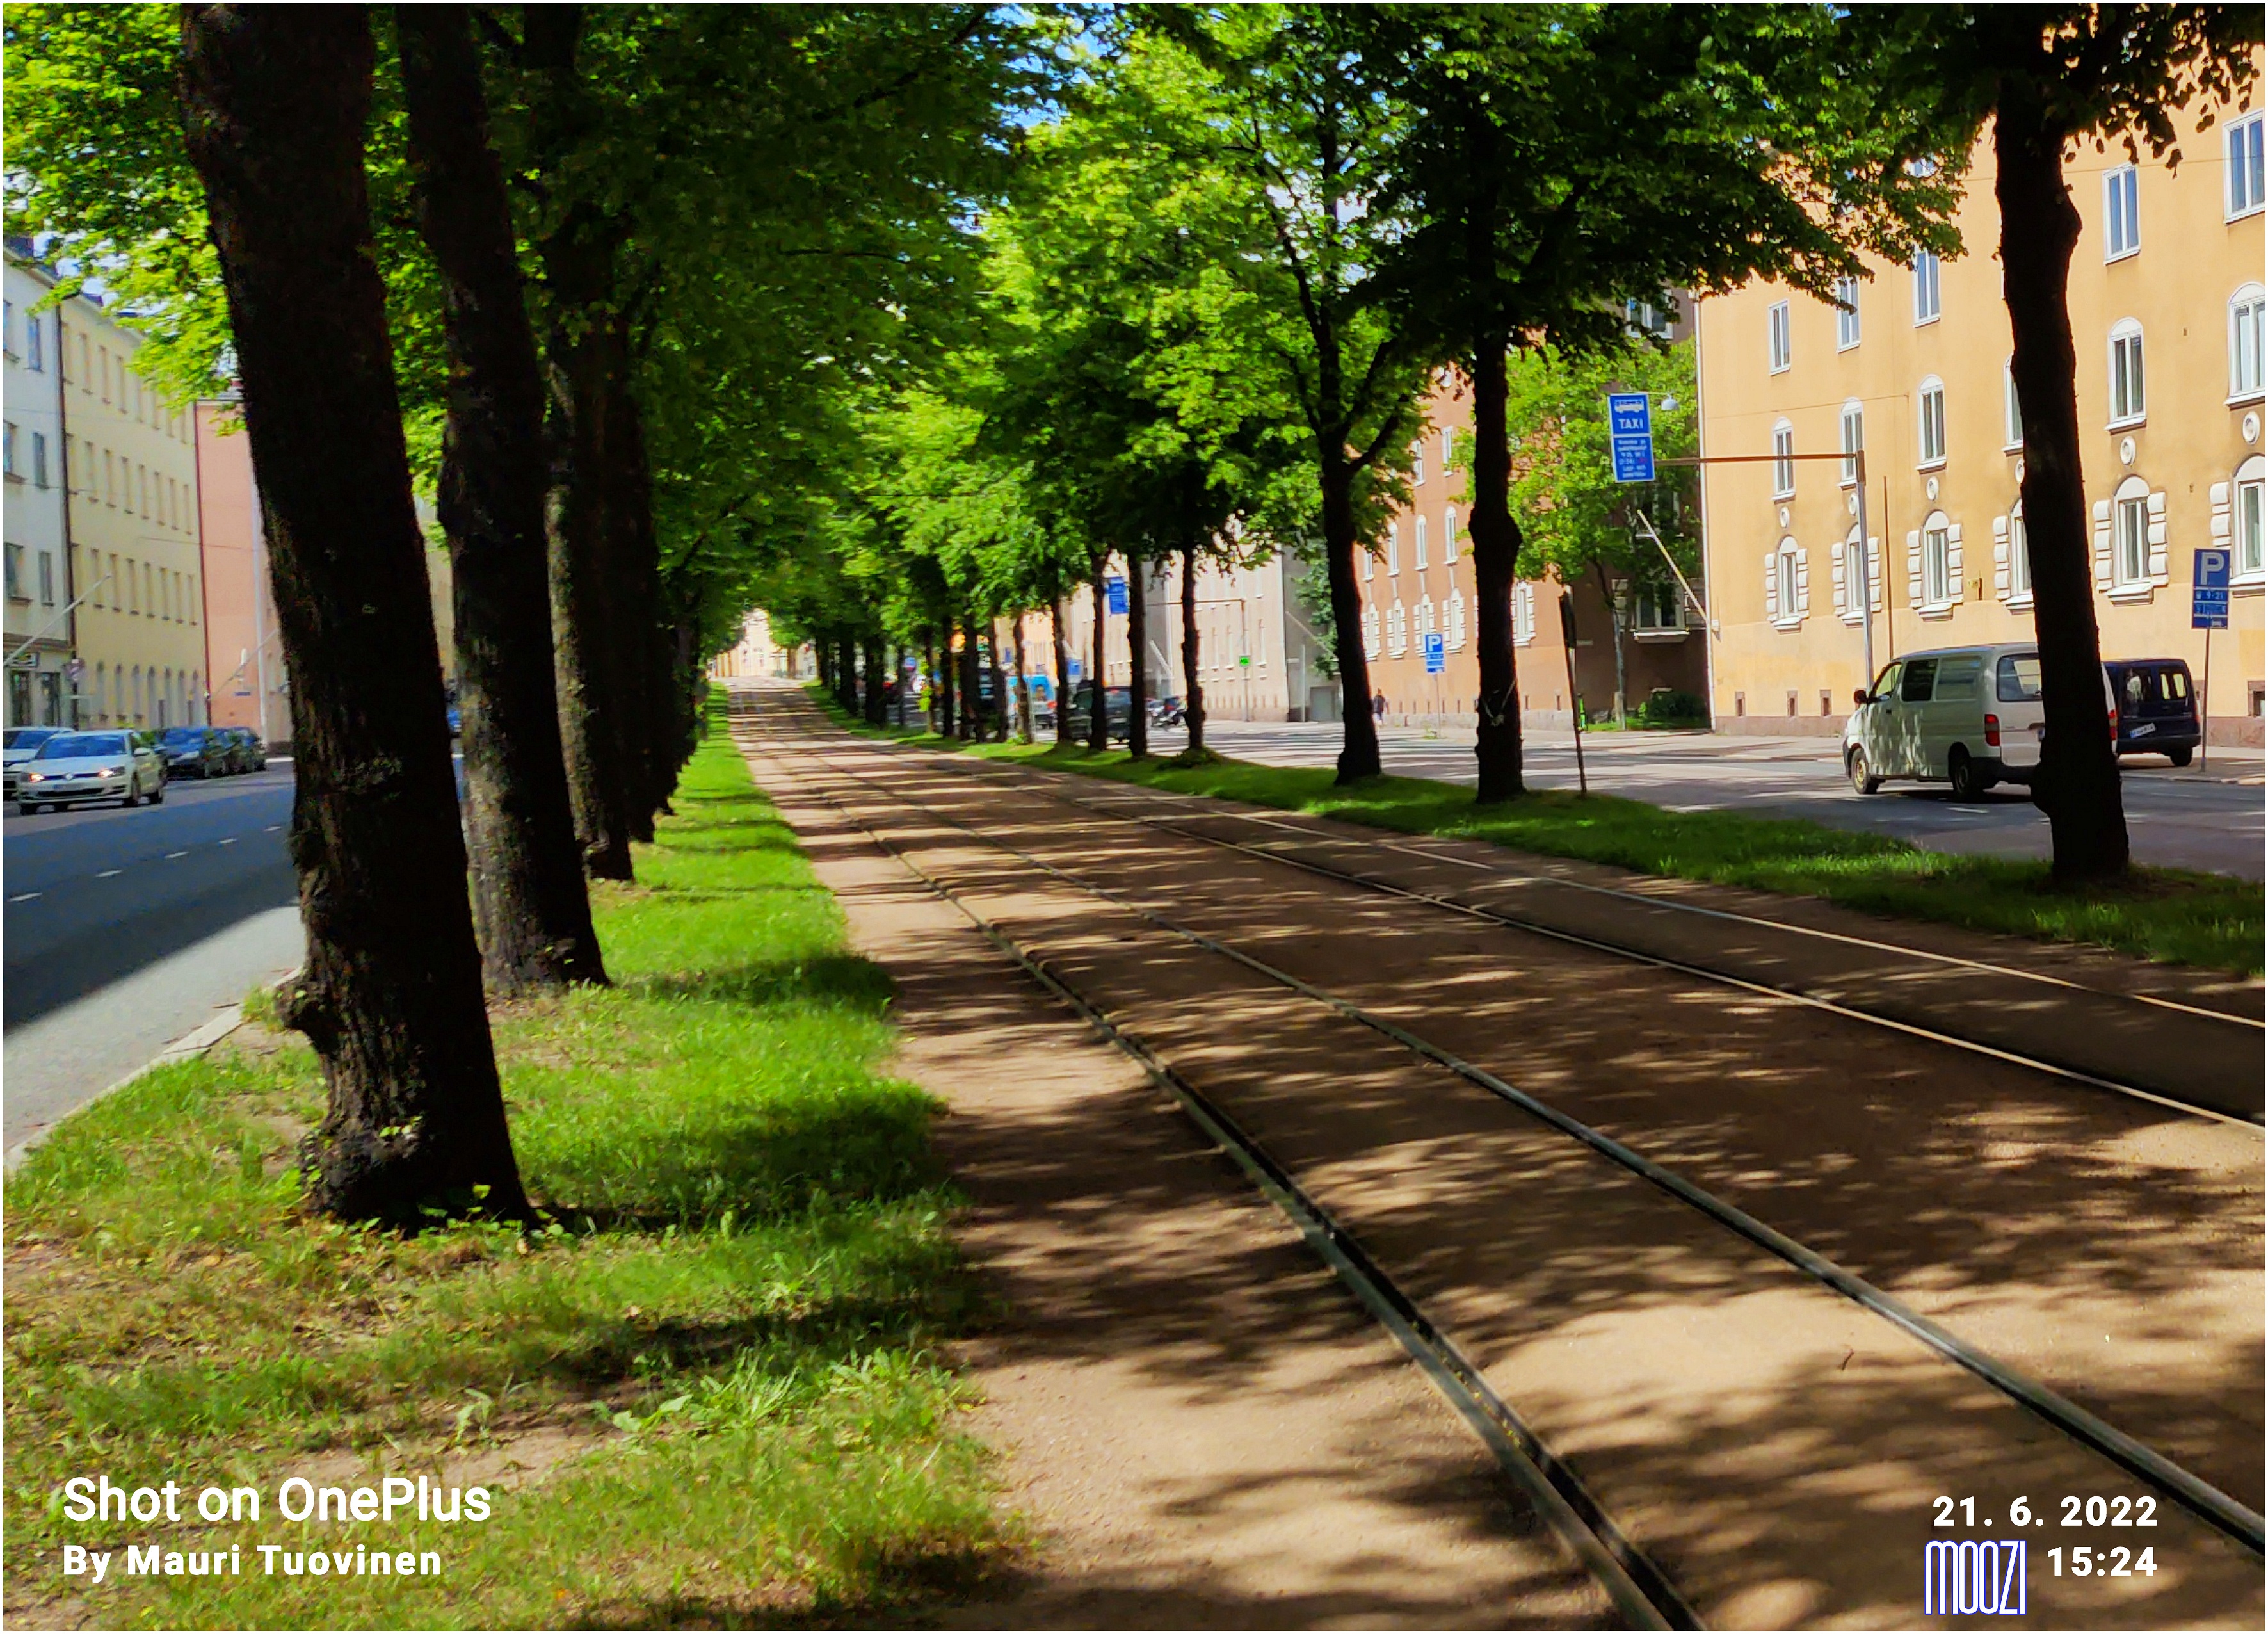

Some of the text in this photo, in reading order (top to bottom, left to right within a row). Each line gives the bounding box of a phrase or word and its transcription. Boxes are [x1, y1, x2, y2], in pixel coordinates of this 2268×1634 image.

[1618, 418, 1643, 429] TAXI
[2201, 552, 2225, 585] P
[1428, 635, 1442, 652] P
